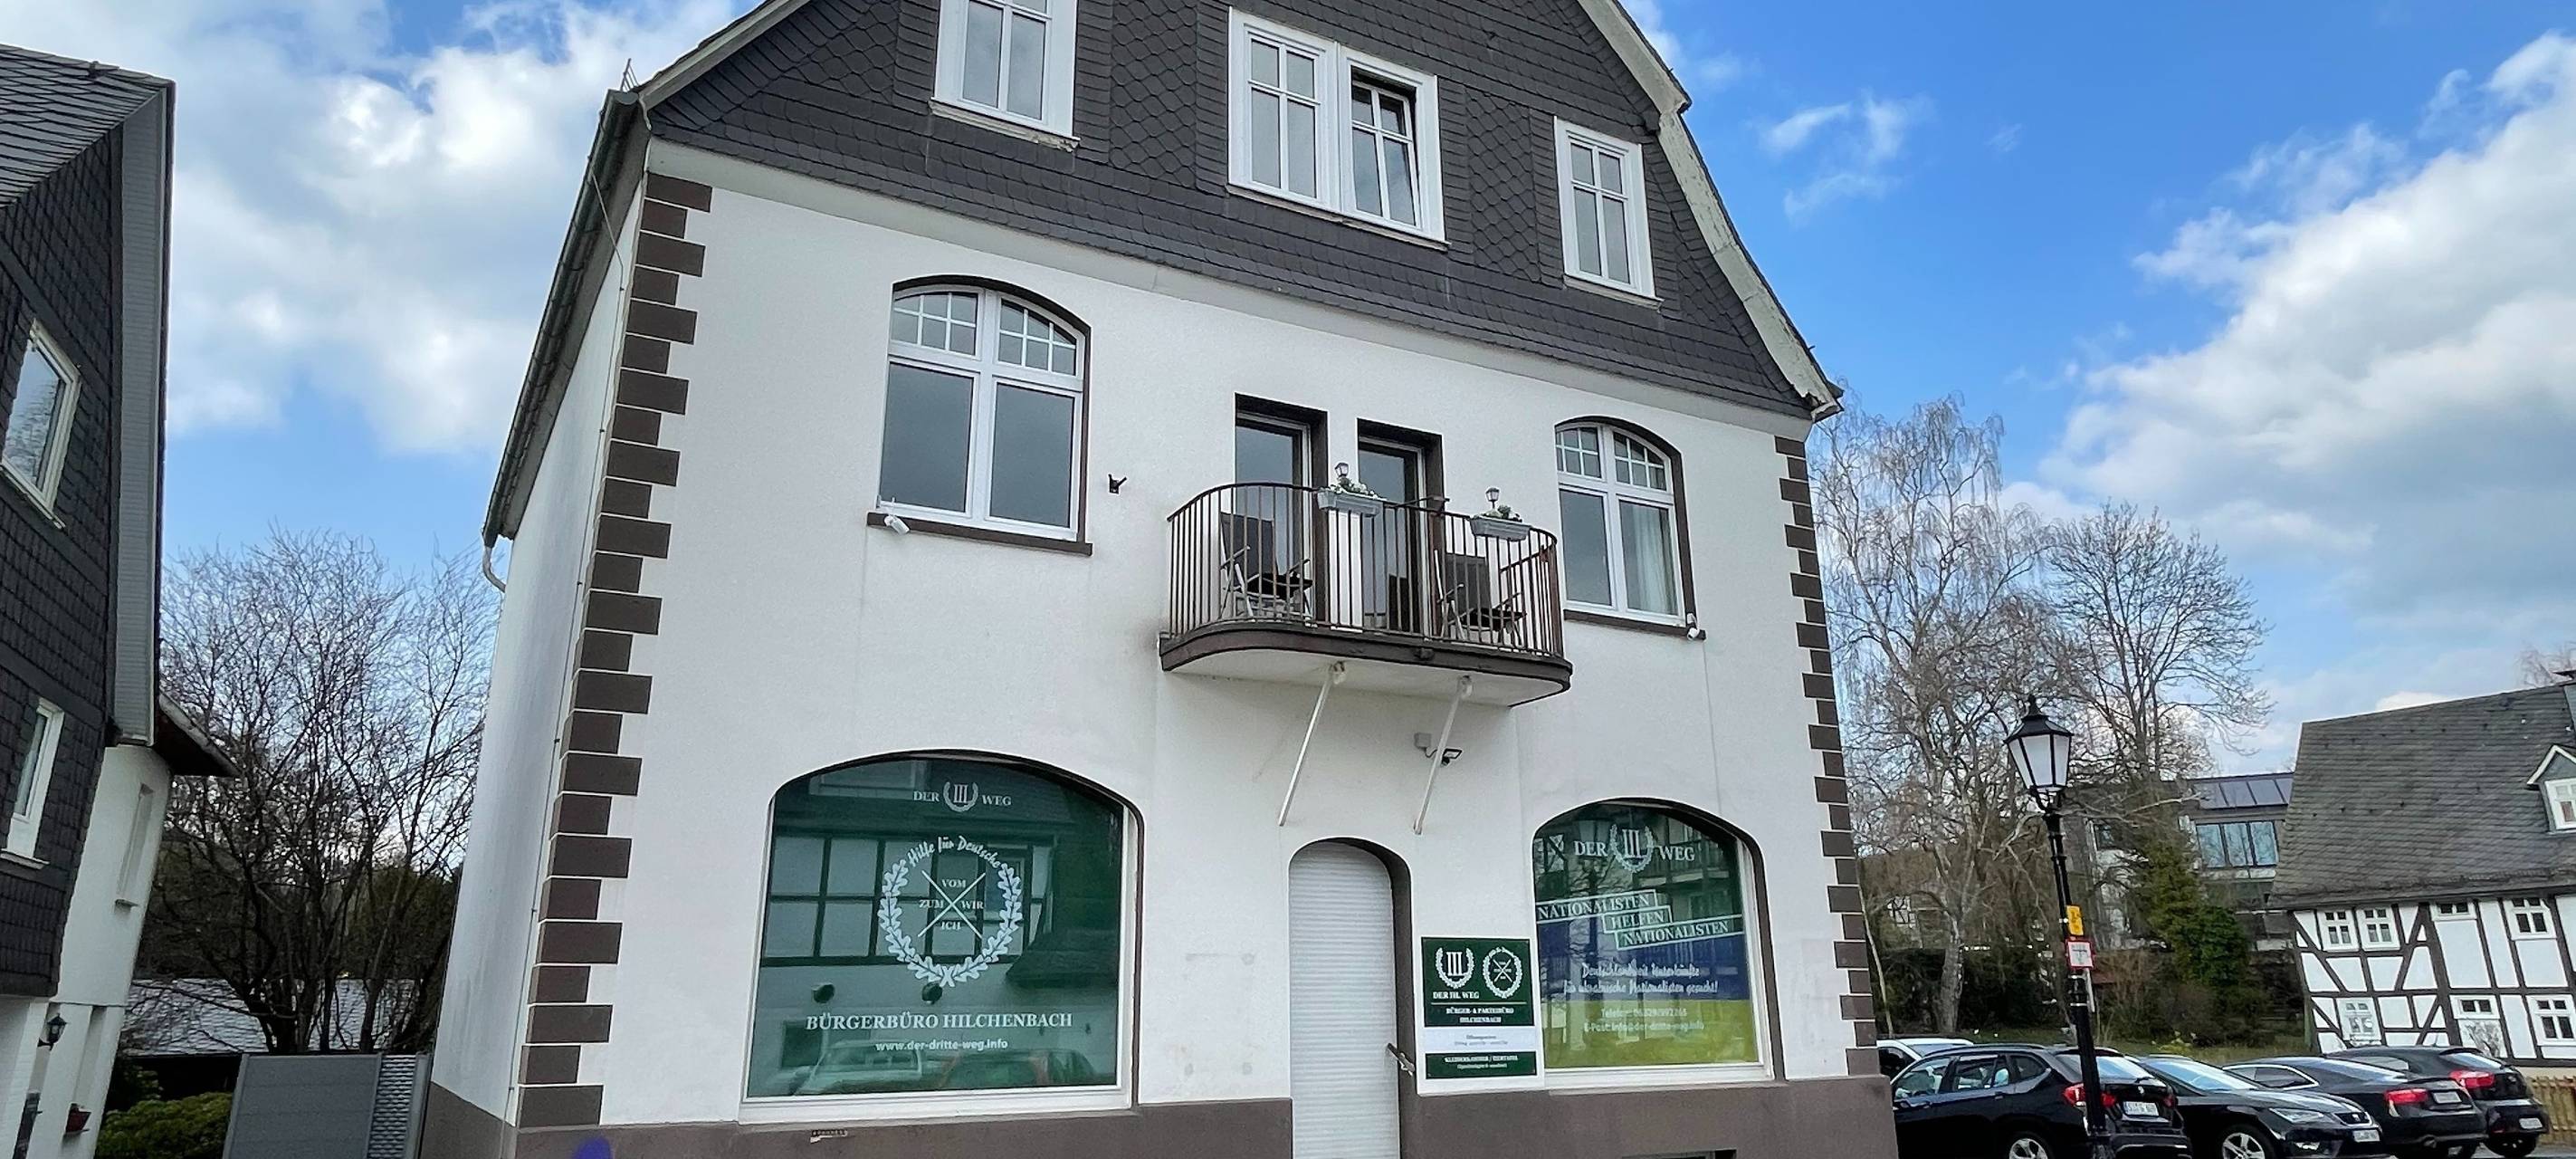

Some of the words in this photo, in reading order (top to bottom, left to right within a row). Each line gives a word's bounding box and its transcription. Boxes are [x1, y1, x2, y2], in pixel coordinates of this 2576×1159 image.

[913, 790, 940, 802] DER
[981, 794, 1012, 806] WEG
[907, 841, 935, 867] Hilfe
[938, 836, 955, 853] für
[957, 835, 1001, 868] Deutsche
[1574, 840, 1608, 857] DER
[1622, 829, 1642, 858] III
[1657, 845, 1695, 861] WEG
[941, 878, 967, 888] VOM
[919, 899, 944, 909] ZUM
[960, 900, 985, 910] WIR
[1538, 894, 1651, 919] NATIONALISTEN
[941, 921, 962, 930] ICH
[1610, 910, 1666, 929] HELFEN
[1621, 921, 1730, 945] NATIONALISTEN
[806, 1011, 939, 1030] BÜRGERBÜRO
[942, 1012, 1073, 1029] HILCHENBACH
[875, 1039, 1008, 1051] www.der-dritte-weg.info
